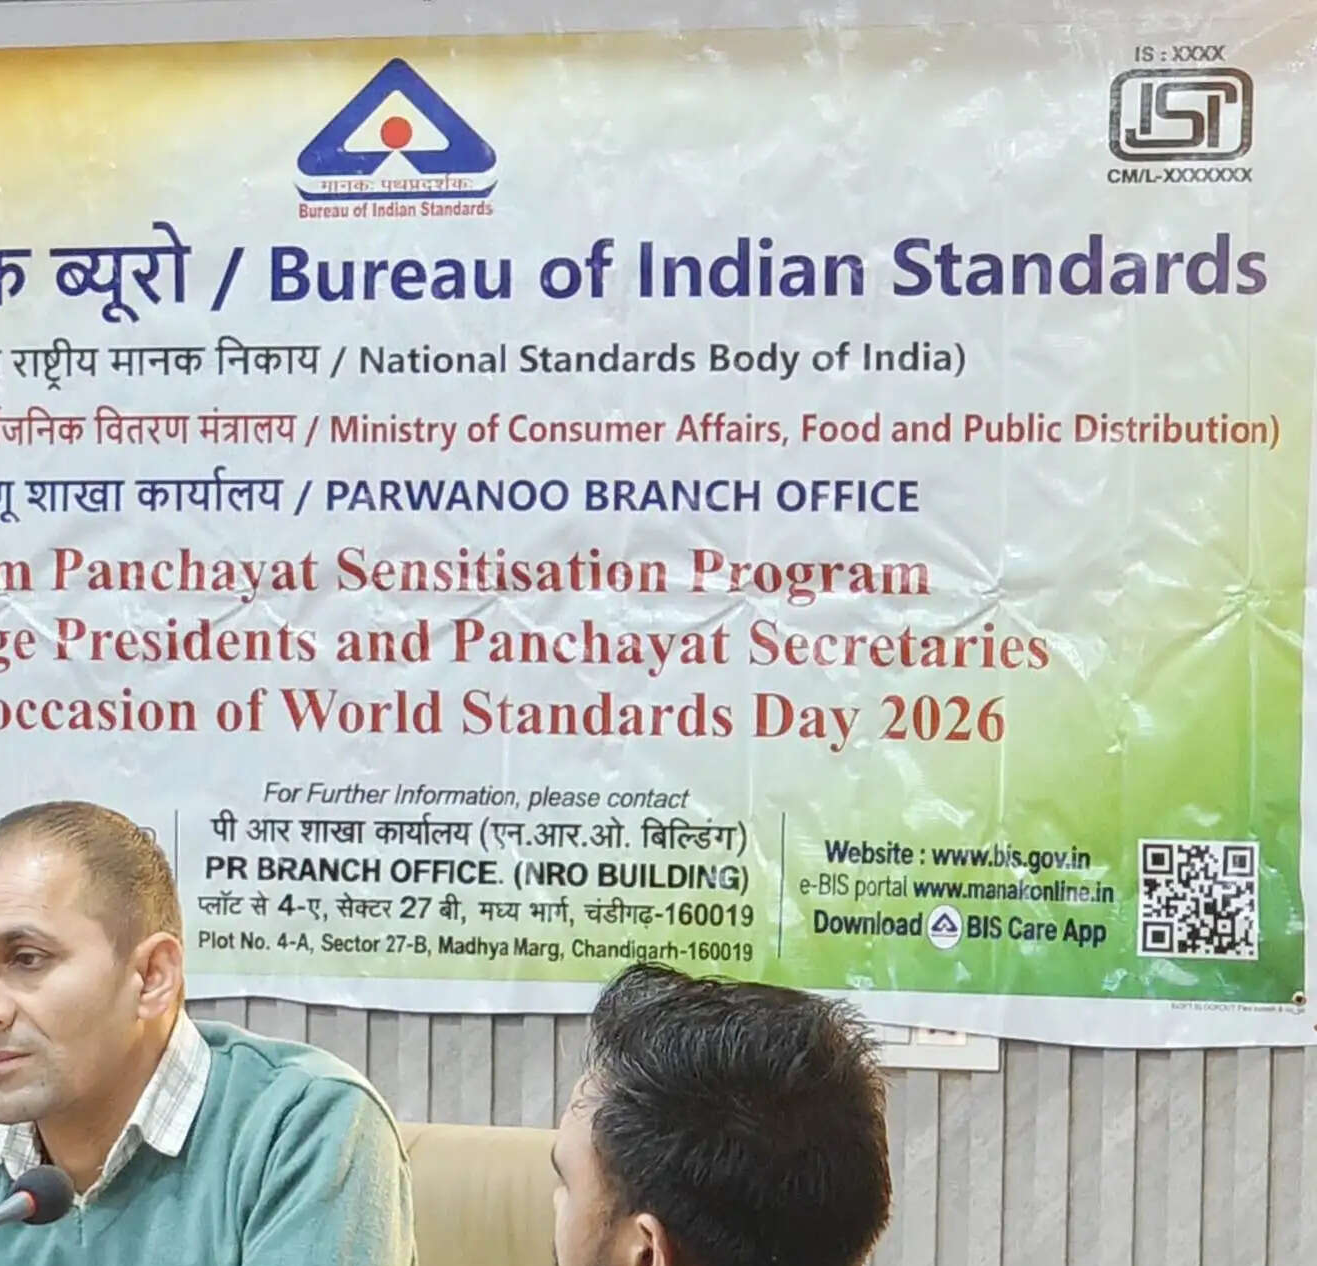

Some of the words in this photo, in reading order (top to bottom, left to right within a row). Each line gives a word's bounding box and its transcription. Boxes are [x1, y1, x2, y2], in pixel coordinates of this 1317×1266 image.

[1134, 46, 1154, 62] IS
[299, 203, 349, 219] Bureau
[353, 202, 366, 217] of
[372, 202, 415, 217] Indian
[421, 200, 493, 217] Standards
[49, 221, 191, 323] ब्यूरो
[210, 247, 245, 312] /
[271, 246, 511, 301] Bureau
[540, 238, 614, 299] of
[640, 237, 864, 298] Indian
[894, 234, 1267, 297] Standards
[11, 338, 99, 390] राष्ट्रीय
[108, 347, 206, 376] मानक
[215, 336, 321, 375] निकाय
[330, 346, 347, 378] /
[360, 345, 506, 374] National
[520, 344, 696, 372] Standards
[709, 344, 799, 380] Body
[812, 344, 849, 372] of
[864, 343, 967, 377] India)
[94, 405, 190, 445] वितरण
[197, 407, 297, 444] मंत्रालय
[305, 416, 319, 447] /
[330, 414, 457, 450] Ministry
[467, 413, 499, 443] of
[508, 414, 666, 443] Consumer
[675, 413, 789, 446] Affairs,
[801, 413, 881, 442] Food
[891, 413, 951, 442] and
[964, 413, 1062, 442] Public
[1074, 413, 1281, 448] Distribution)
[25, 480, 125, 512] शाखा
[135, 465, 284, 512] कार्यालय
[293, 480, 313, 516] /
[326, 480, 568, 512] PARWANOO
[585, 480, 761, 511] BRANCH
[776, 480, 920, 512] OFFICE
[51, 547, 318, 602] Panchayat
[336, 547, 668, 593] Sensitisation
[689, 548, 931, 607] Program
[55, 617, 317, 662] Presidents
[336, 619, 430, 663] and
[451, 618, 730, 678] Panchayat
[749, 619, 1051, 669] Secretaries
[216, 687, 267, 733] of
[279, 688, 443, 734] World
[462, 690, 733, 737] Standards
[753, 692, 860, 753] Day
[879, 695, 1006, 743] 2026
[264, 782, 298, 804] For
[306, 783, 387, 805] Further
[395, 784, 521, 809] Information,
[527, 787, 601, 811] please
[608, 788, 690, 809] contact
[211, 809, 237, 843] पी
[246, 818, 293, 843] आर
[298, 820, 365, 844] शाखा
[373, 812, 472, 846] कार्यालय
[640, 816, 748, 857] बिल्डिंग)
[206, 856, 248, 881] PR
[257, 857, 381, 883] BRANCH
[514, 861, 588, 890] (NRO
[598, 863, 749, 896] BUILDING)
[825, 840, 914, 865] Website
[932, 845, 1091, 873] www.bis.gov.in
[250, 890, 269, 916] से
[335, 893, 391, 918] सेक्टर
[399, 896, 432, 919] 27
[438, 893, 466, 924] बी,
[799, 873, 849, 897] e-BIS
[855, 876, 907, 900] portal
[914, 880, 1115, 903] www.manakonline.in
[198, 931, 234, 948] Plot
[240, 932, 269, 950] No.
[277, 933, 314, 953] 4-A,
[321, 933, 381, 952] Sector
[386, 935, 432, 956] 27-B,
[438, 936, 509, 958] Madhya
[515, 938, 564, 961] Marg,
[572, 939, 753, 961] Chandigarh-160019
[814, 909, 923, 936] Download
[967, 914, 1003, 939] BIS
[1008, 917, 1057, 941] Care
[1062, 919, 1107, 947] App
